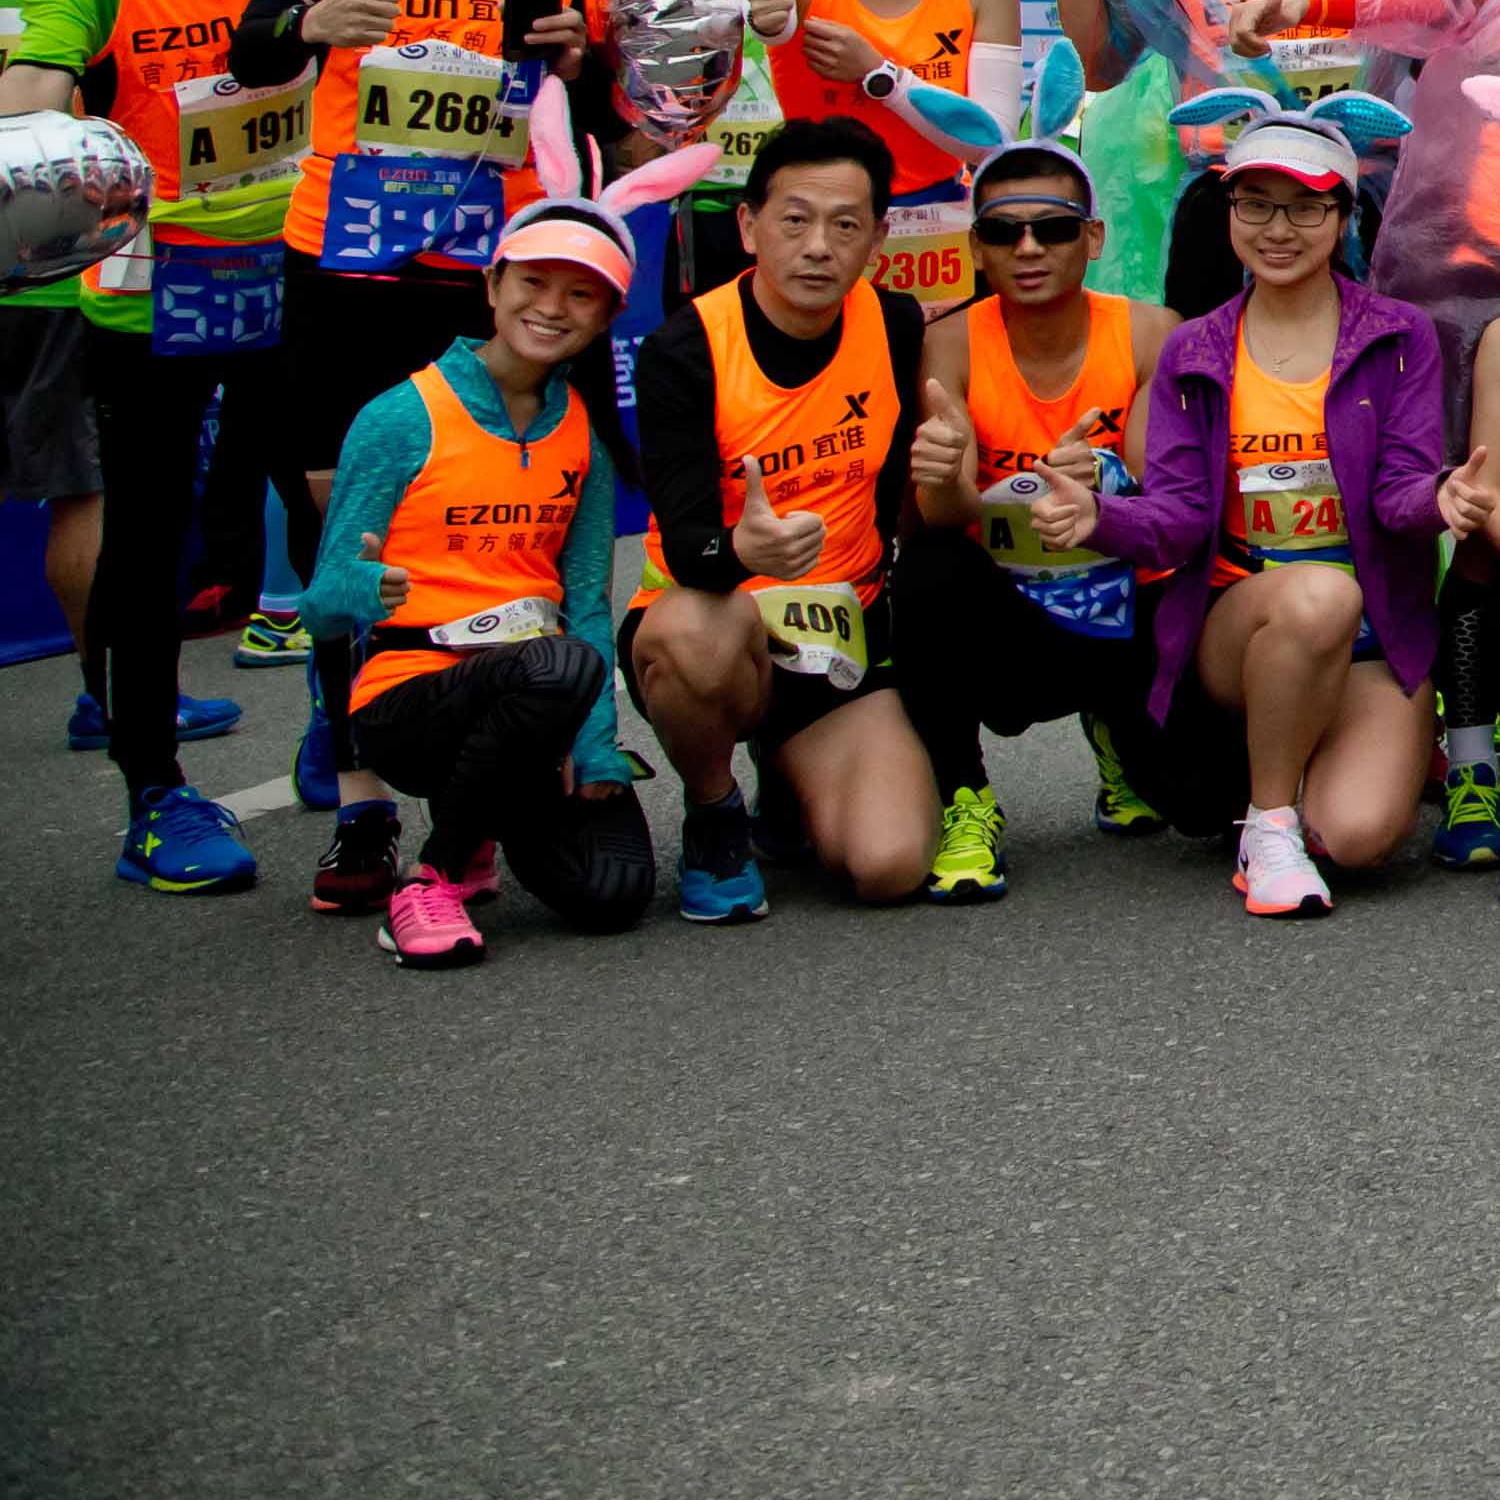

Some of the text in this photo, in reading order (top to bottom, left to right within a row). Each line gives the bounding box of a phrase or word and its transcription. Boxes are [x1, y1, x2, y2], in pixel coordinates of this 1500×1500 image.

[131, 15, 235, 55] EZON
[363, 84, 515, 138] A 2684
[188, 100, 305, 166] A 1911
[871, 246, 962, 293] 2305
[811, 425, 867, 461] 宜准
[1229, 432, 1304, 454] EZON
[775, 458, 866, 500] 领跑员
[446, 502, 576, 527] EZON 宜准
[989, 515, 1016, 551] A
[1251, 499, 1277, 535] A
[782, 600, 852, 642] 406
